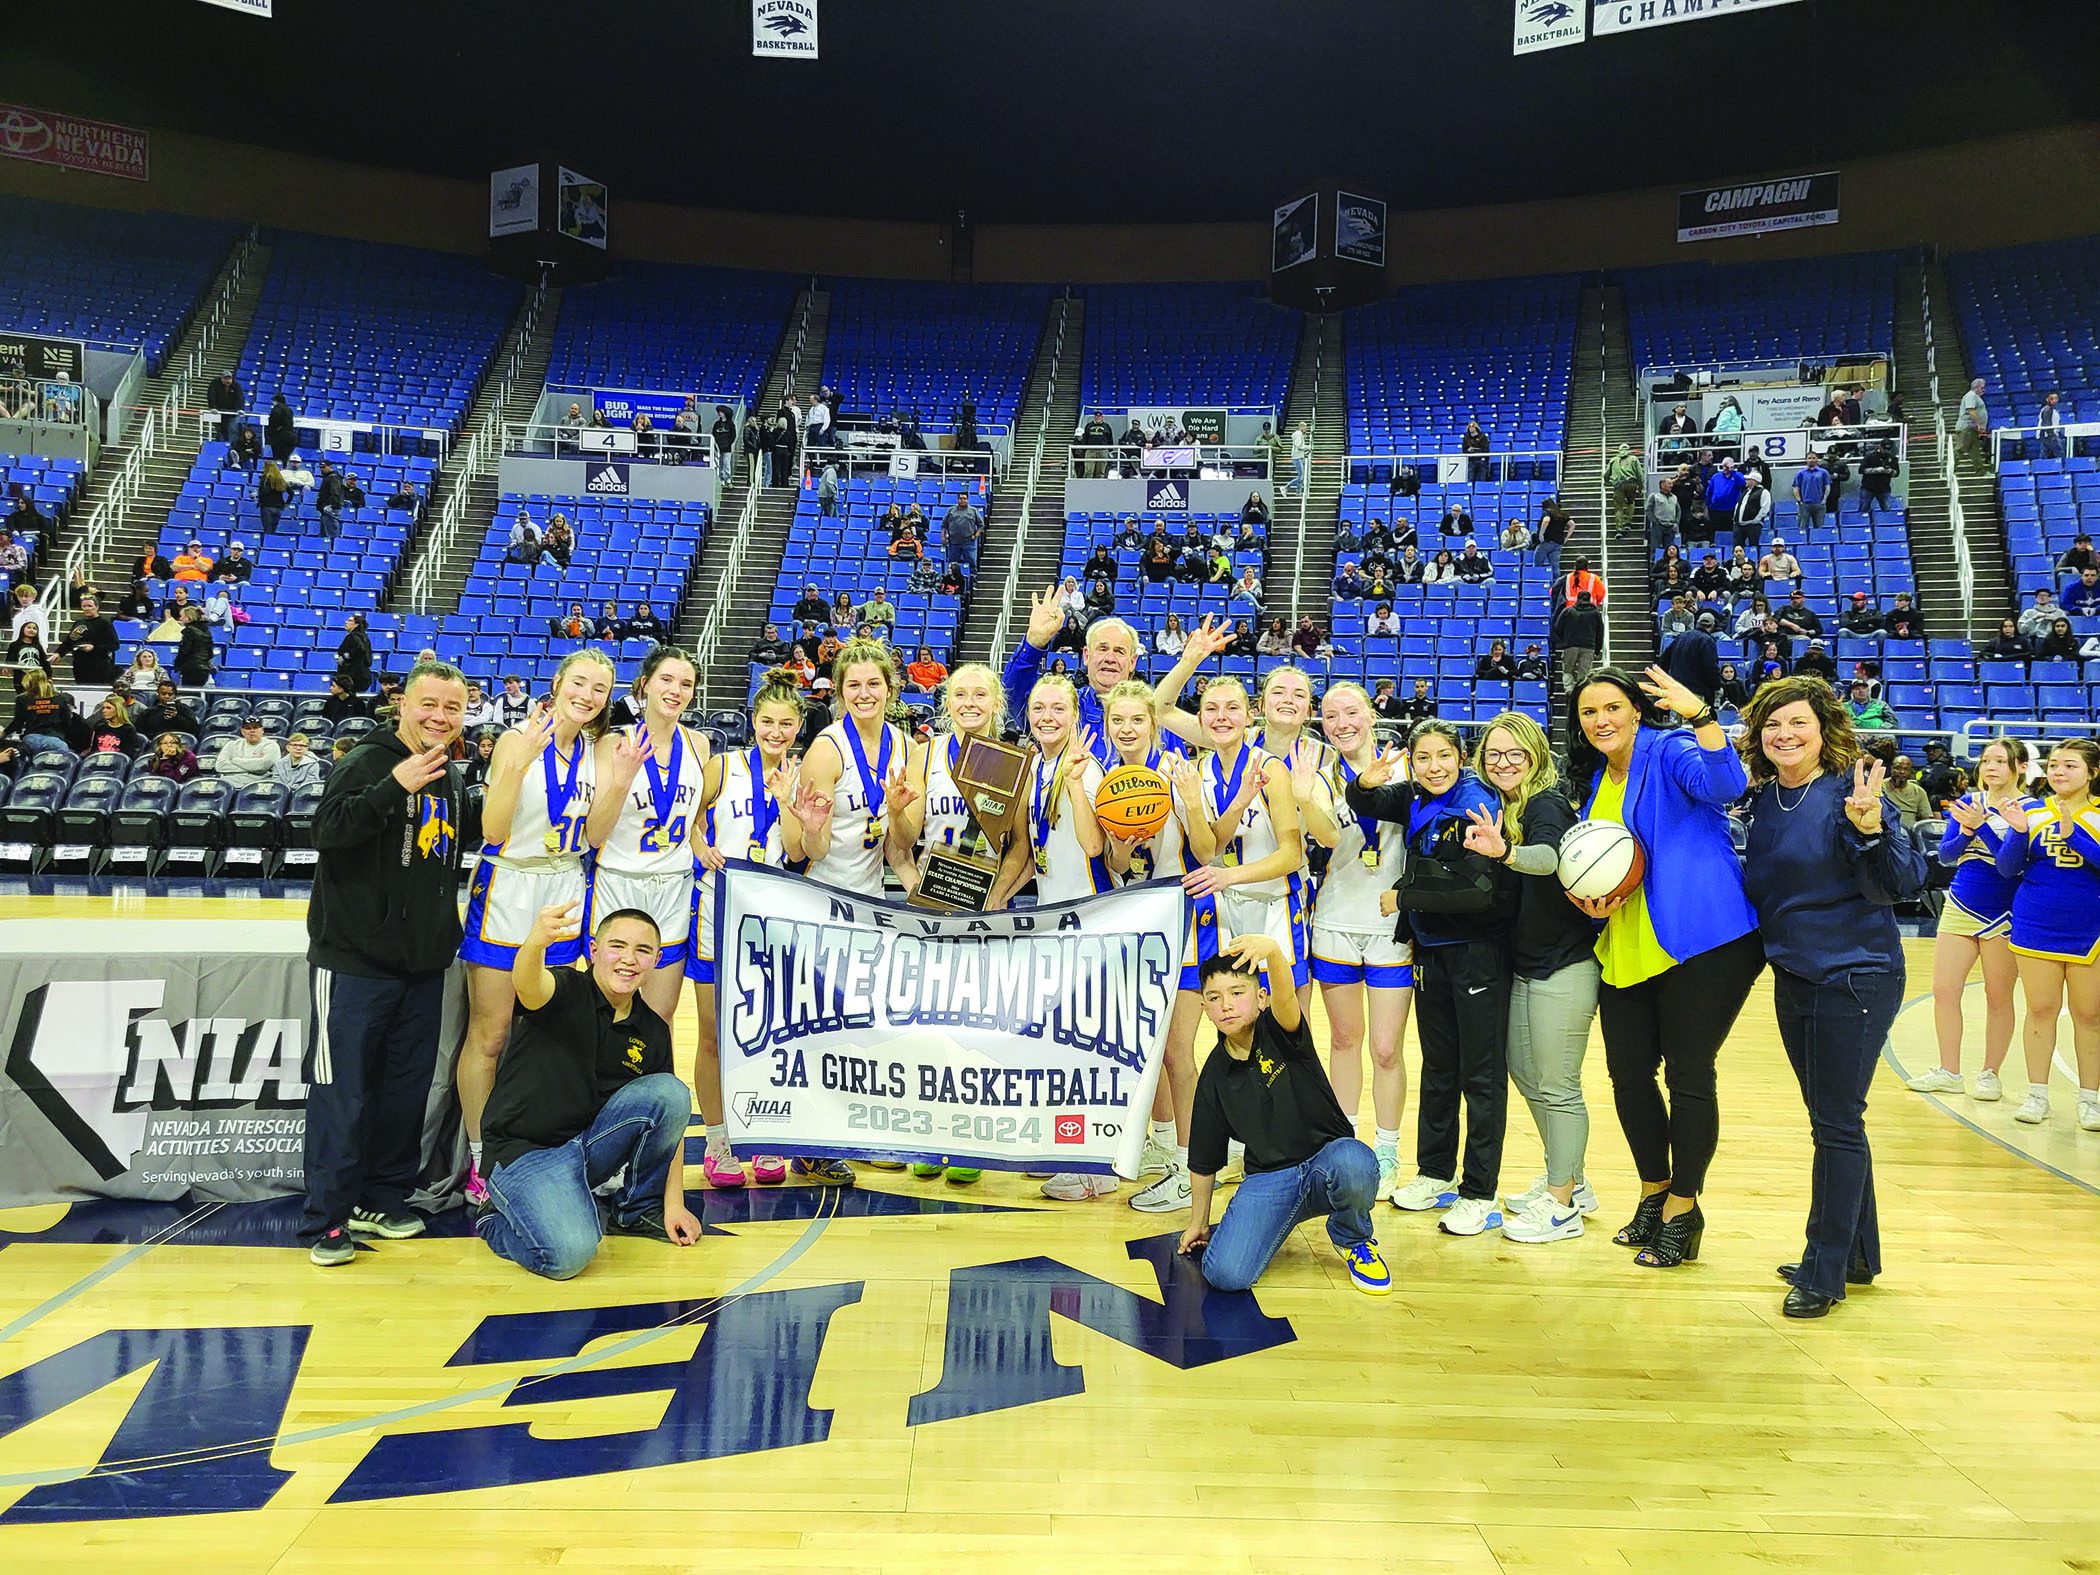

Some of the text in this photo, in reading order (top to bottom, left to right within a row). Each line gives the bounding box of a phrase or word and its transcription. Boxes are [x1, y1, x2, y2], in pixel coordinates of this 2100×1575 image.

[757, 1, 813, 20] NEVADA
[1517, 26, 1581, 46] BASKETBALL
[757, 41, 815, 50] BASKETBALL
[55, 120, 145, 149] NORTHERN
[55, 134, 144, 165] NEVADA
[1704, 179, 1811, 212] CAMPAGNI
[1345, 207, 1378, 226] NEVADA
[604, 401, 629, 411] BUD
[1757, 398, 1769, 406] Key
[330, 435, 342, 449] 3
[602, 434, 615, 447] 4
[1765, 436, 1786, 457] 8
[898, 458, 909, 472] 5
[1448, 463, 1459, 476] 7
[587, 482, 628, 493] adidas
[1149, 499, 1187, 508] adidas
[1109, 776, 1162, 795] Wilson
[632, 784, 696, 811] LORY
[982, 798, 1005, 812] NIAA
[927, 870, 987, 894] STATE CHAMPIONSHIPS
[829, 898, 1080, 937] NEVADA
[732, 914, 1171, 1074] STATE CHAMPIONS
[770, 1048, 1128, 1107] 3A GIRLS BASKETBALL
[748, 1100, 791, 1115] NIAA
[151, 1120, 210, 1137] NEVADA
[848, 1102, 1042, 1144] 2023-2024
[233, 1138, 302, 1153] ASSOCIA
[247, 1166, 284, 1179] youth
